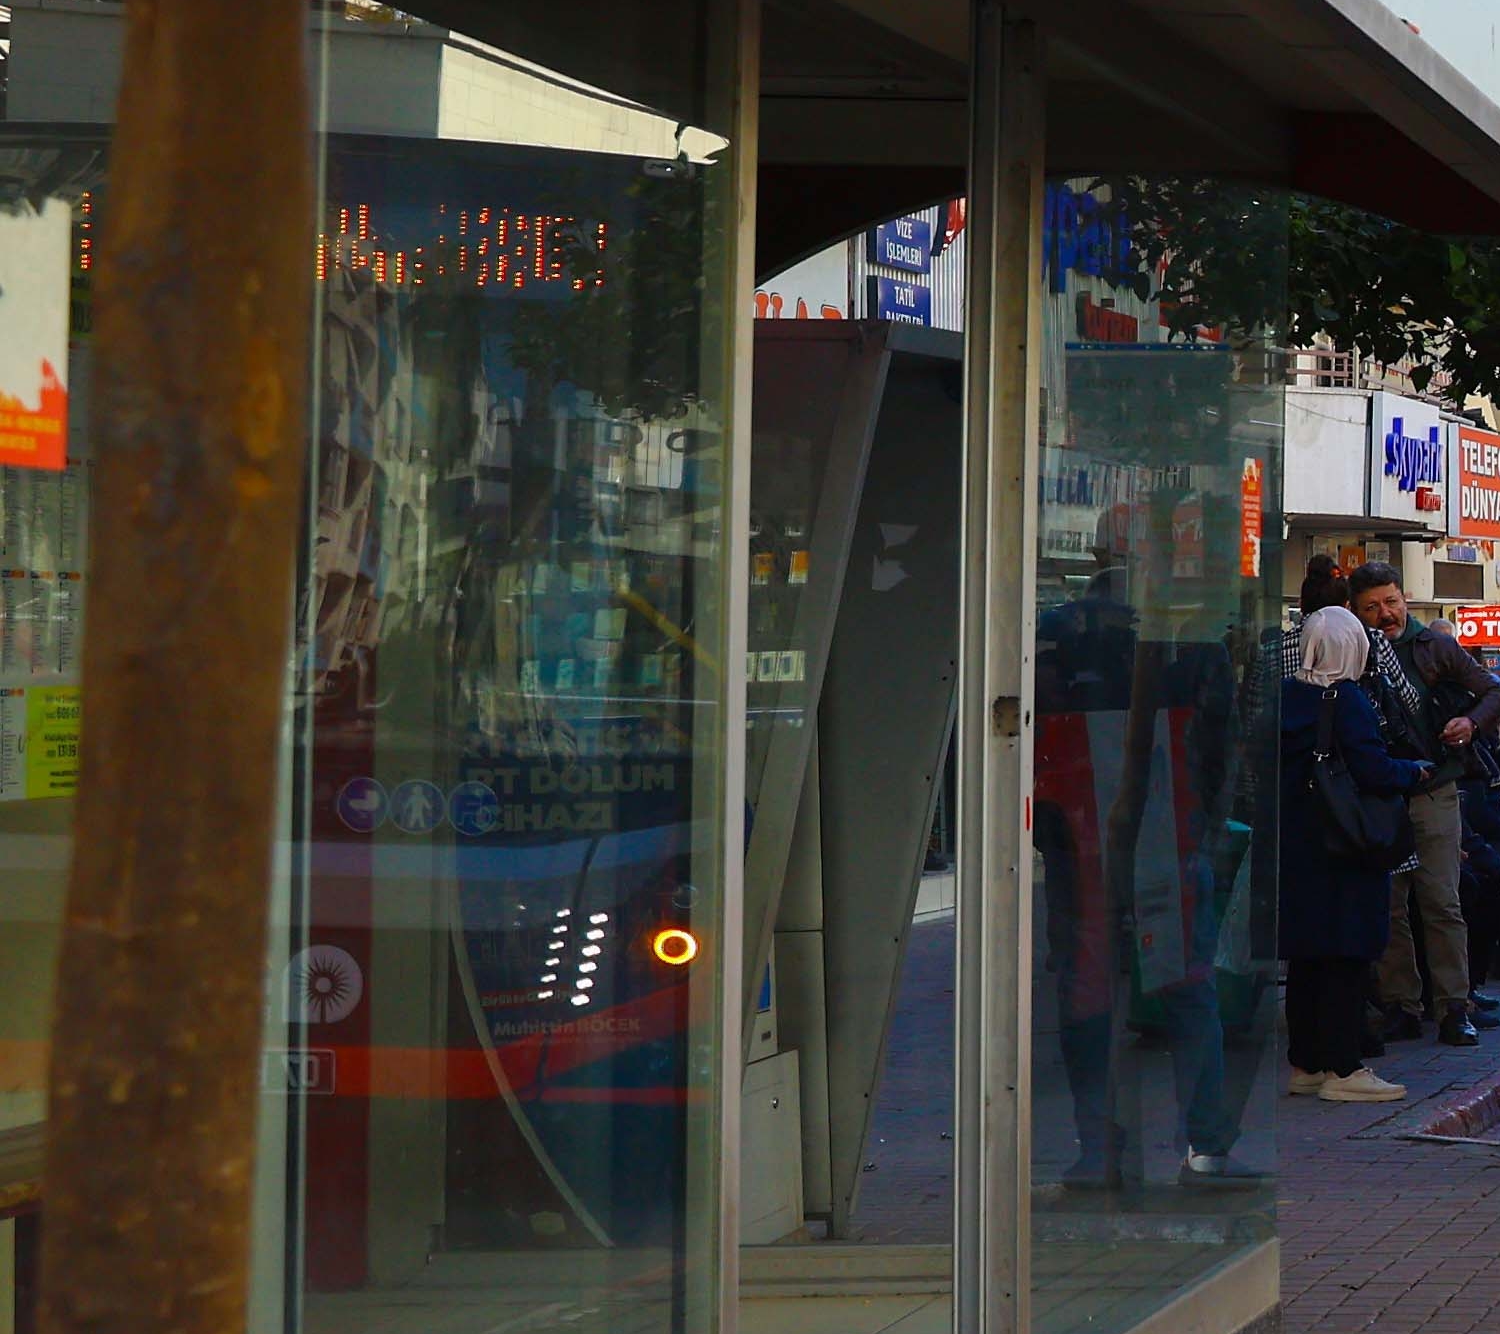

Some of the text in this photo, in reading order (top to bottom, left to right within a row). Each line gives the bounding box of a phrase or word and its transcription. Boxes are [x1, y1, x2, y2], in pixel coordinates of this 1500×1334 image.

[895, 218, 913, 240] VİZE
[886, 243, 922, 267] İŞLEMLERİ
[894, 285, 916, 308] TATİL
[1385, 417, 1444, 492] skypark
[529, 763, 675, 794] DOLUM
